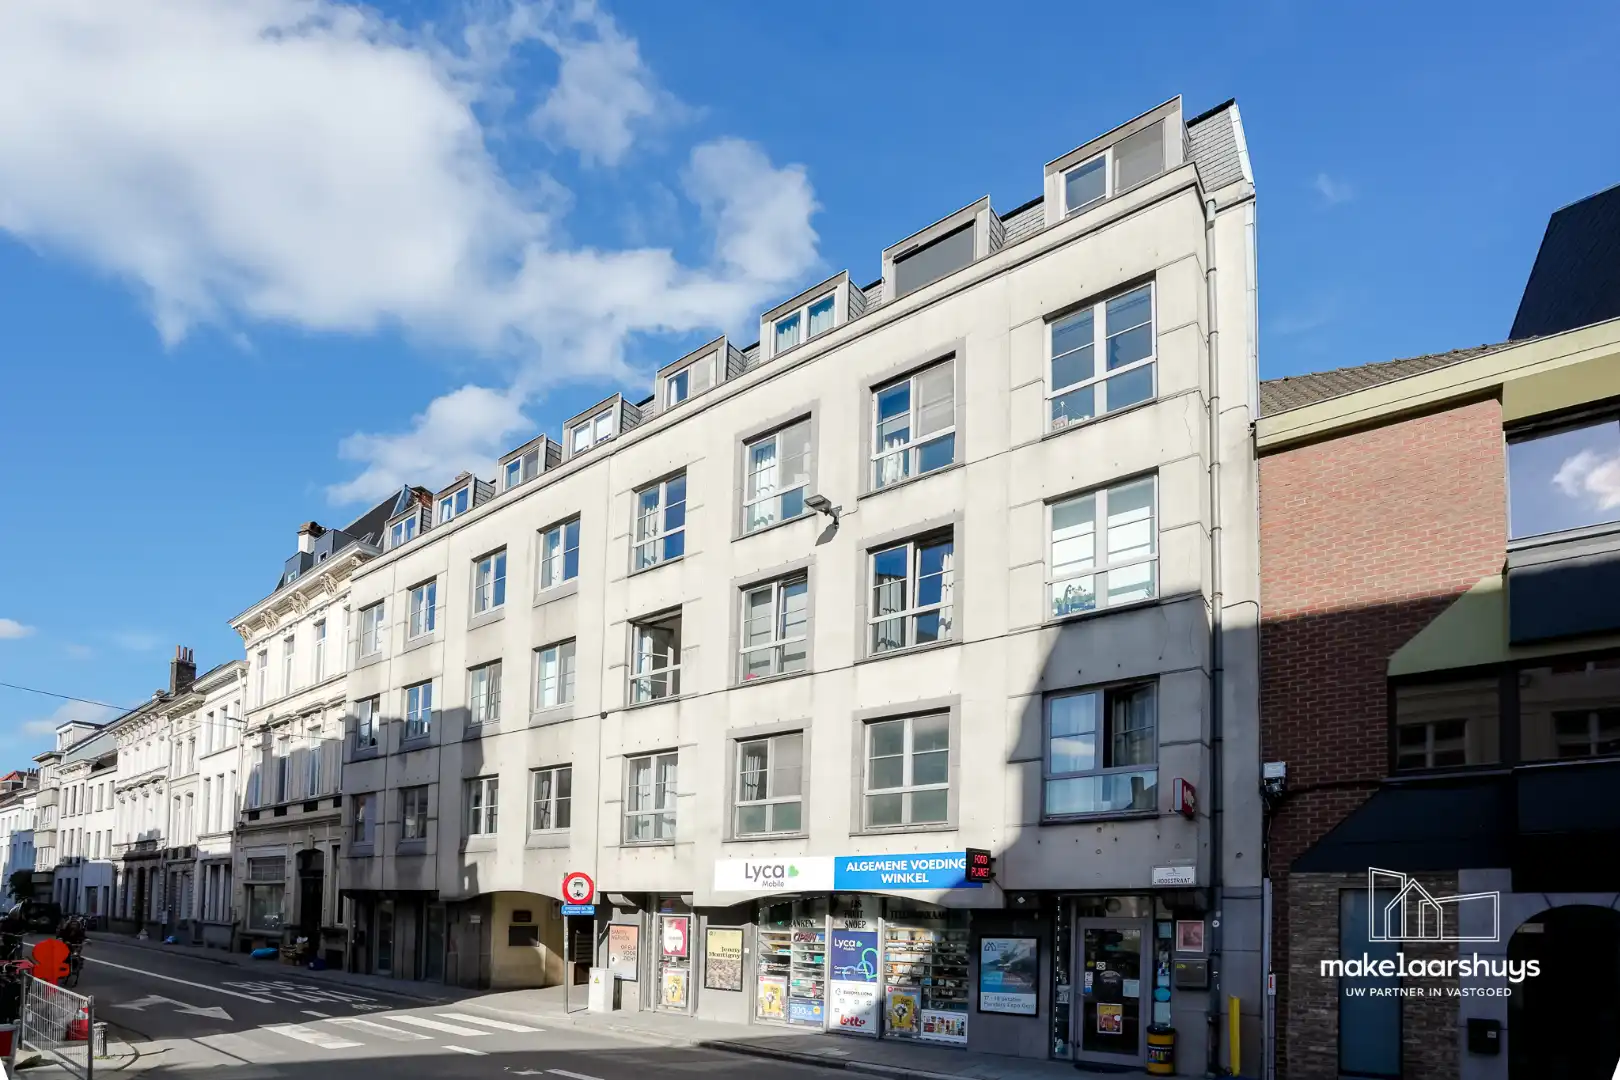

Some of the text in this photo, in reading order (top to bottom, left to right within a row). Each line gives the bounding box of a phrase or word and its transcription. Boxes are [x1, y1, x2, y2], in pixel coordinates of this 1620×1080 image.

[846, 857, 966, 872] ALGEMENE VOEDING
[974, 854, 988, 865] FOOD
[744, 862, 785, 882] Lyca
[881, 872, 929, 884] WINKEL
[971, 866, 990, 878] PLANET
[761, 880, 785, 888] Mobile
[844, 920, 867, 929] SNOEP
[834, 937, 856, 949] Lyca
